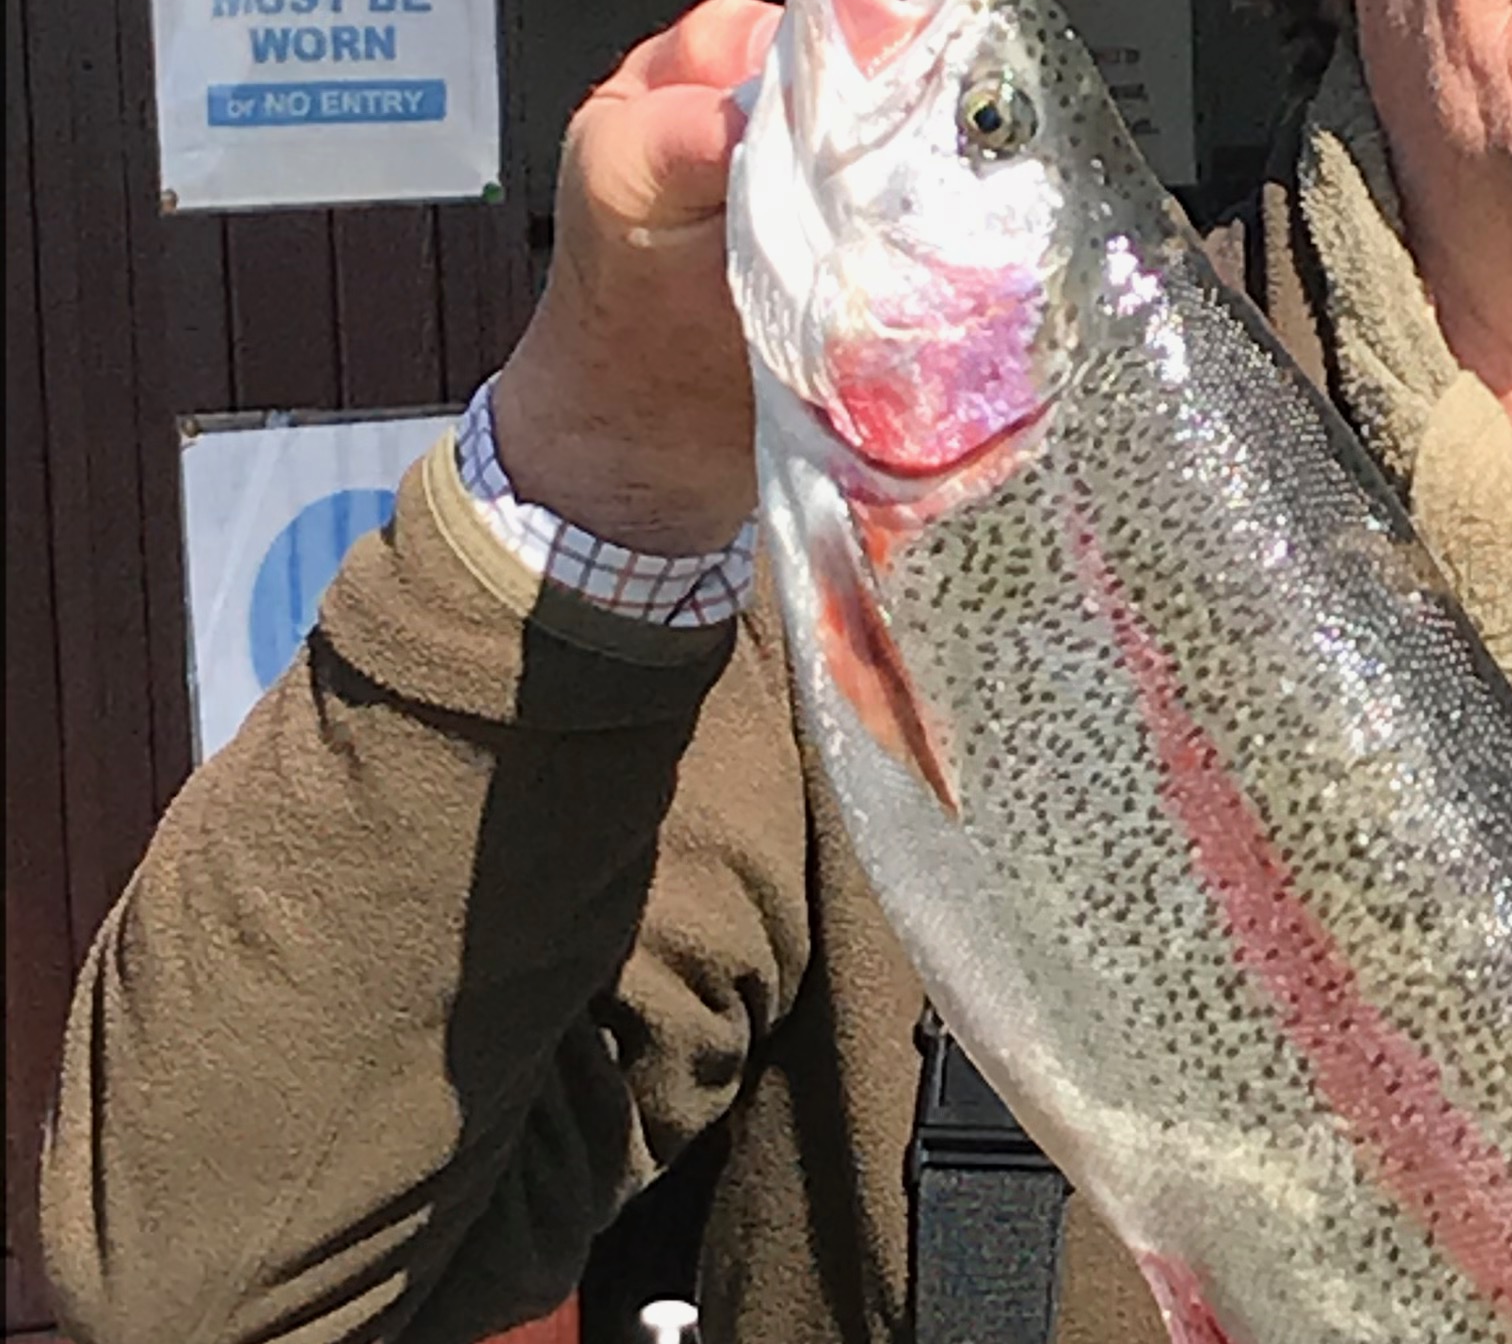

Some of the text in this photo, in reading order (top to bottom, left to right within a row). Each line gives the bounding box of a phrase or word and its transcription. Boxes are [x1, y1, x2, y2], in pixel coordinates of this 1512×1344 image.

[249, 27, 397, 65] WORN
[263, 93, 311, 118] NO
[319, 90, 425, 117] ENTRY
